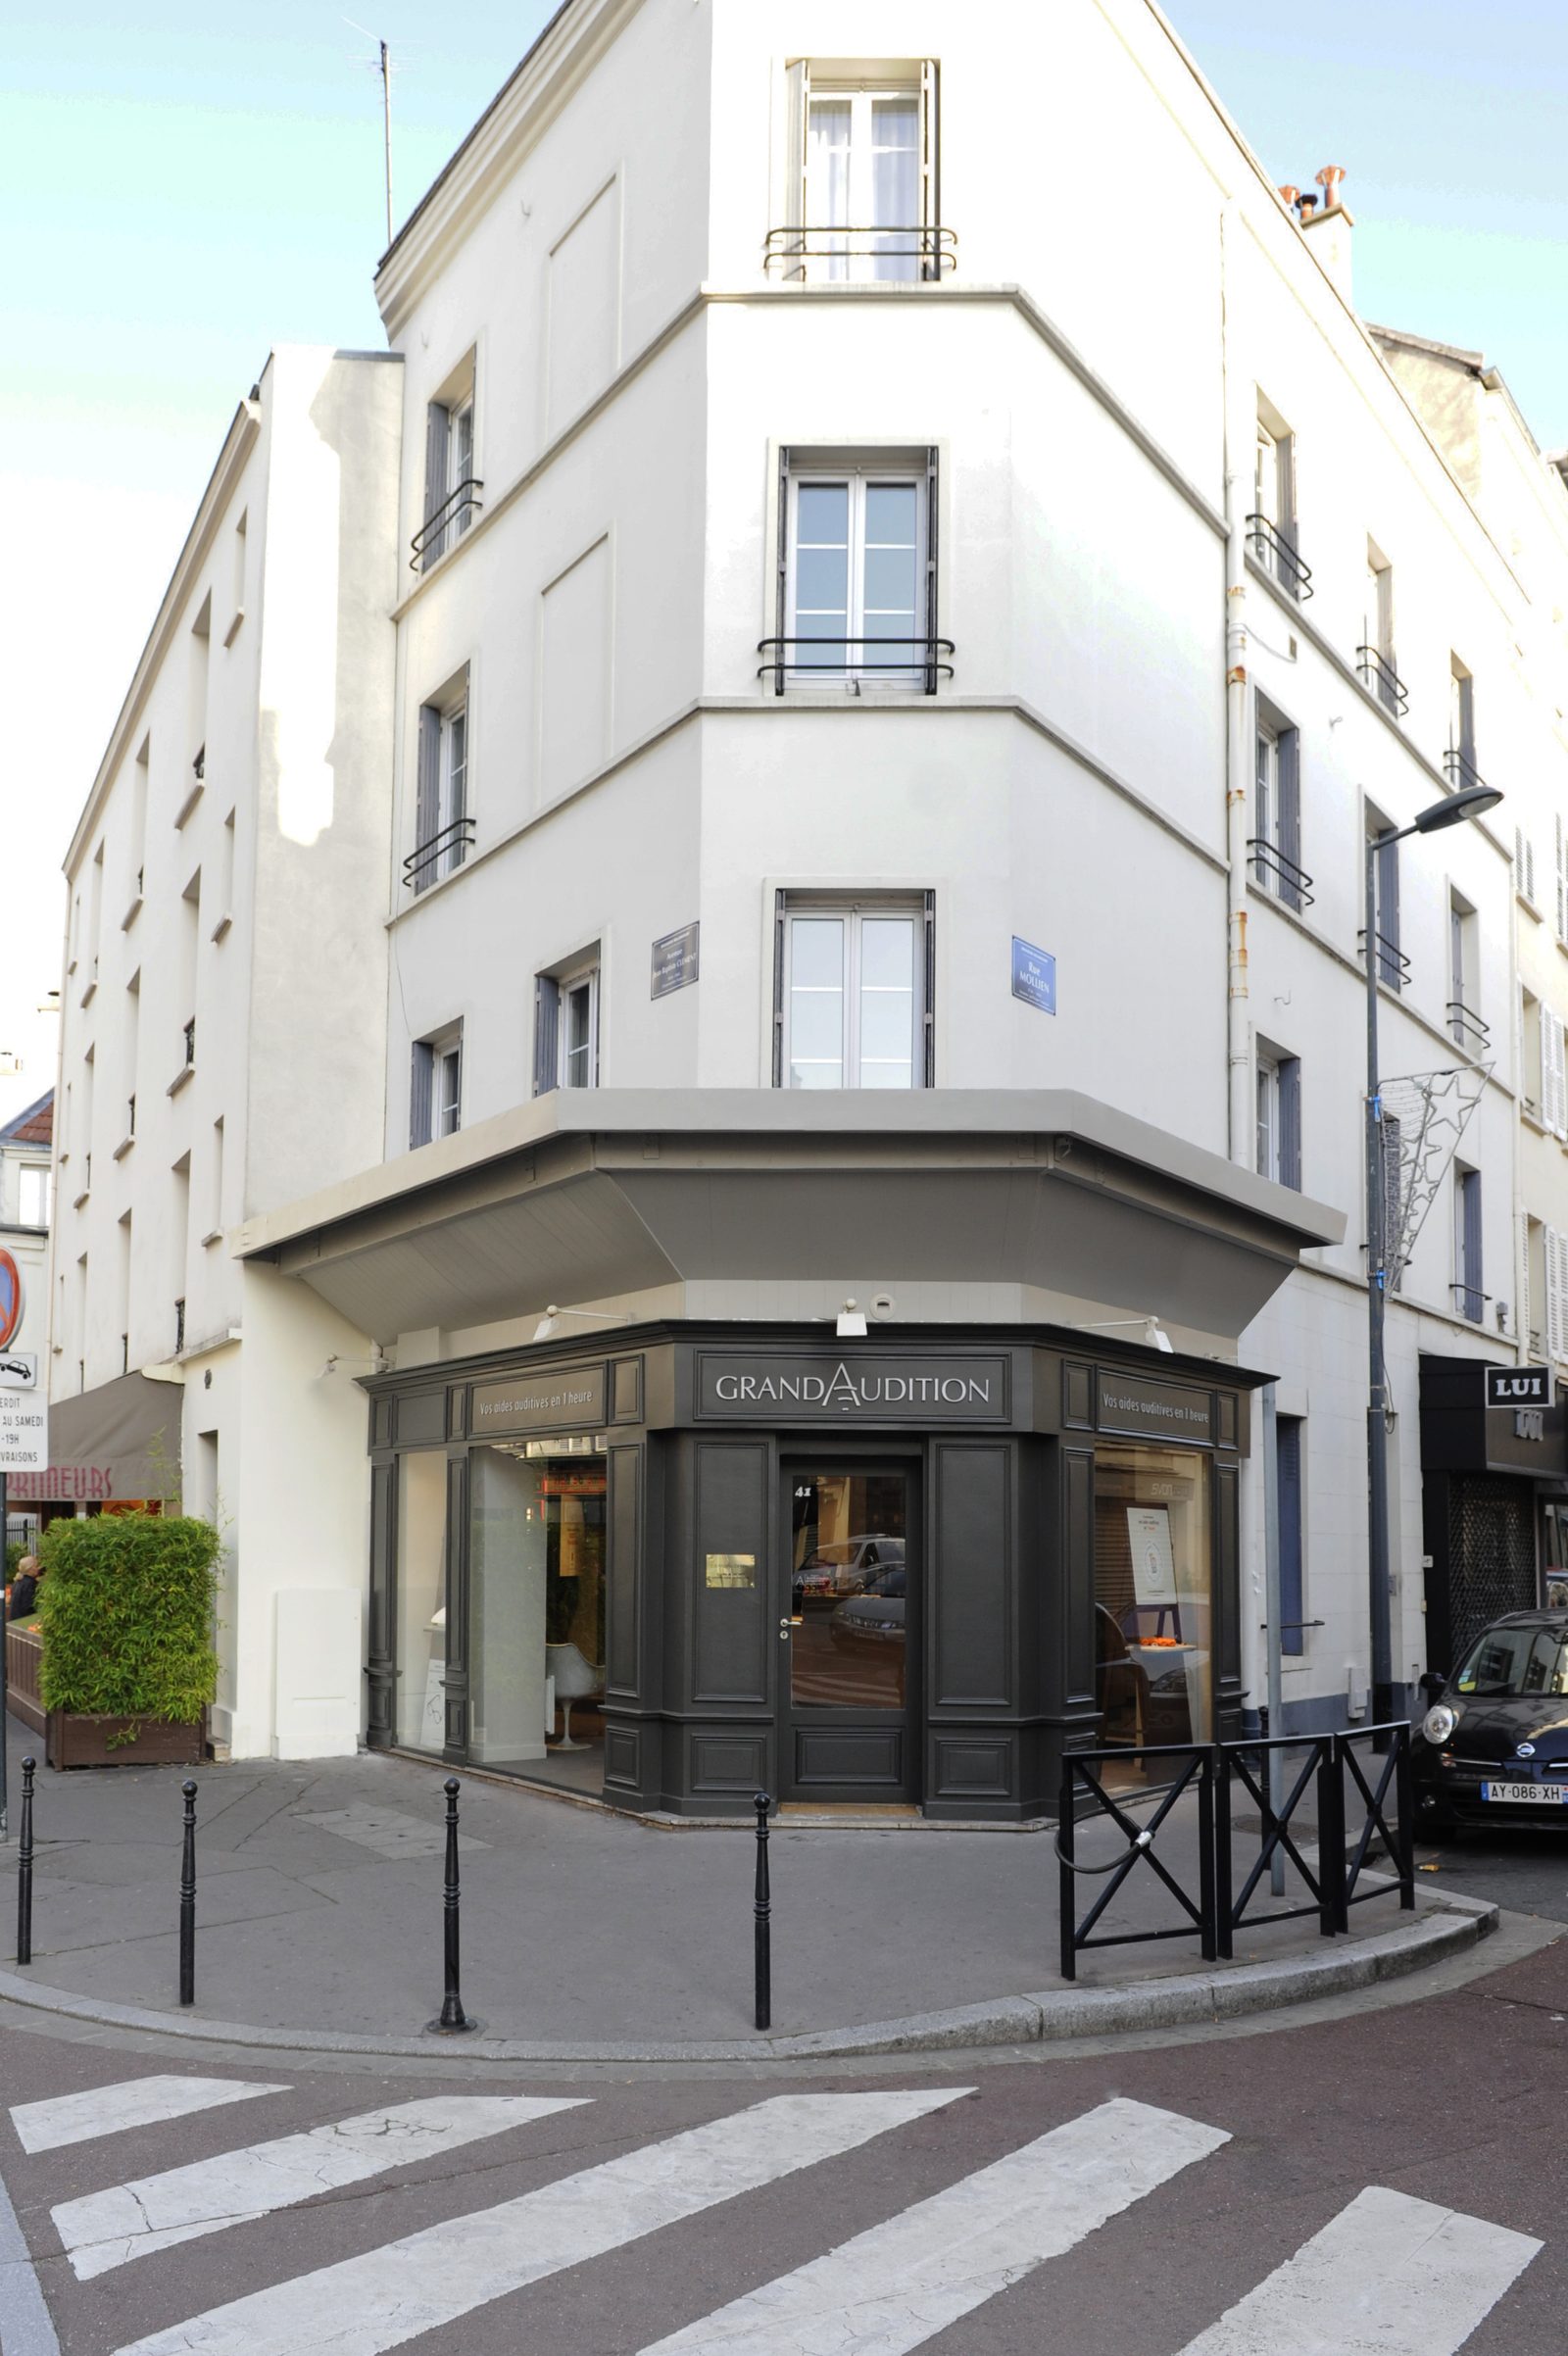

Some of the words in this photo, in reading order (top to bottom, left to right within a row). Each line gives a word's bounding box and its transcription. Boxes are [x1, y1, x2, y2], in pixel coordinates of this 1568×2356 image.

[1028, 961, 1041, 976] Rue
[1019, 970, 1050, 994] MOLLIEN
[1495, 1377, 1542, 1397] LUI
[480, 1402, 492, 1415] Vos
[494, 1399, 513, 1413] aides
[514, 1396, 549, 1411] auditives
[551, 1396, 561, 1407] en
[563, 1392, 566, 1405] 1
[568, 1391, 593, 1404] heure
[1103, 1393, 1117, 1408] Vos
[1118, 1396, 1140, 1412] aides
[1141, 1401, 1174, 1418] auditives
[1175, 1409, 1184, 1420] en
[1190, 1407, 1209, 1423] heure
[2, 1416, 13, 1427] AU
[15, 1416, 44, 1427] SAMEDI
[794, 1486, 811, 1497] 41
